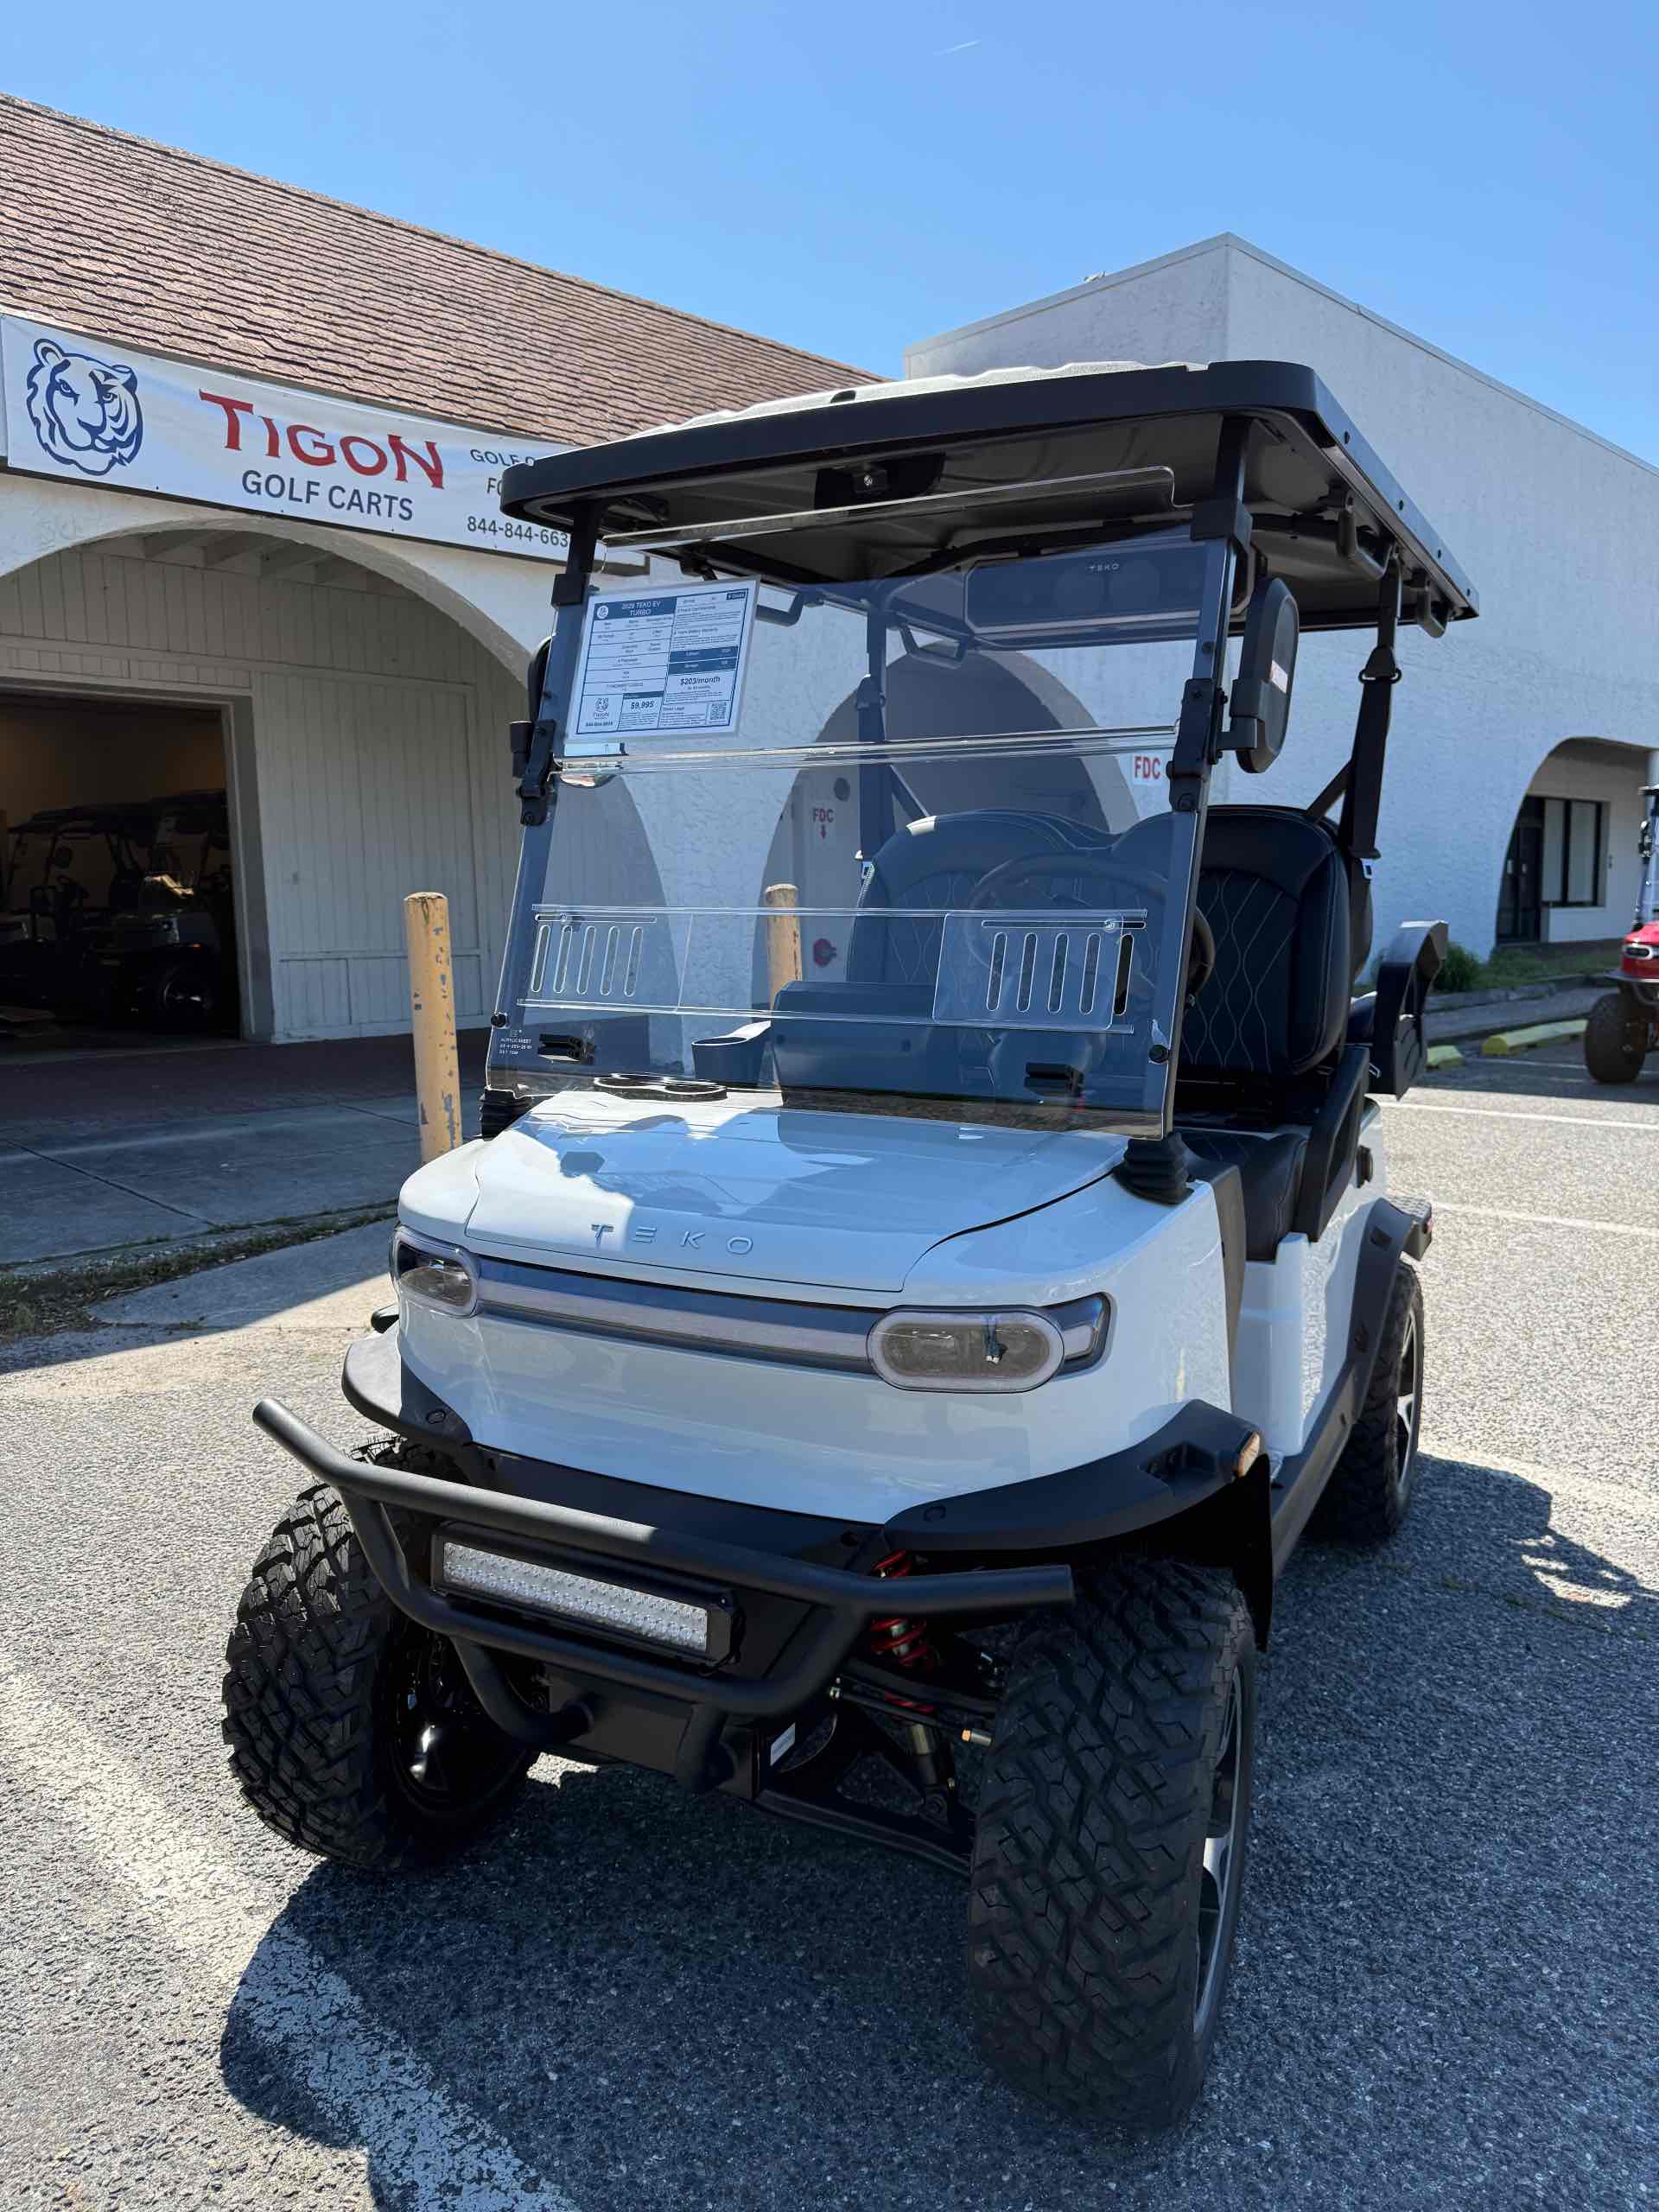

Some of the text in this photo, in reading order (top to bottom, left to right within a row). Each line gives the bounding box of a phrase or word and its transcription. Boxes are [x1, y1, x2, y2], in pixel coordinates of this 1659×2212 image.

[199, 388, 445, 490] TIGON
[470, 448, 520, 467] GOLF
[242, 469, 414, 522] GOLF CARTS
[467, 516, 569, 548] 844-844-663
[1134, 755, 1161, 779] FDC
[812, 808, 835, 823] FDC
[591, 1224, 754, 1255] TEKO
